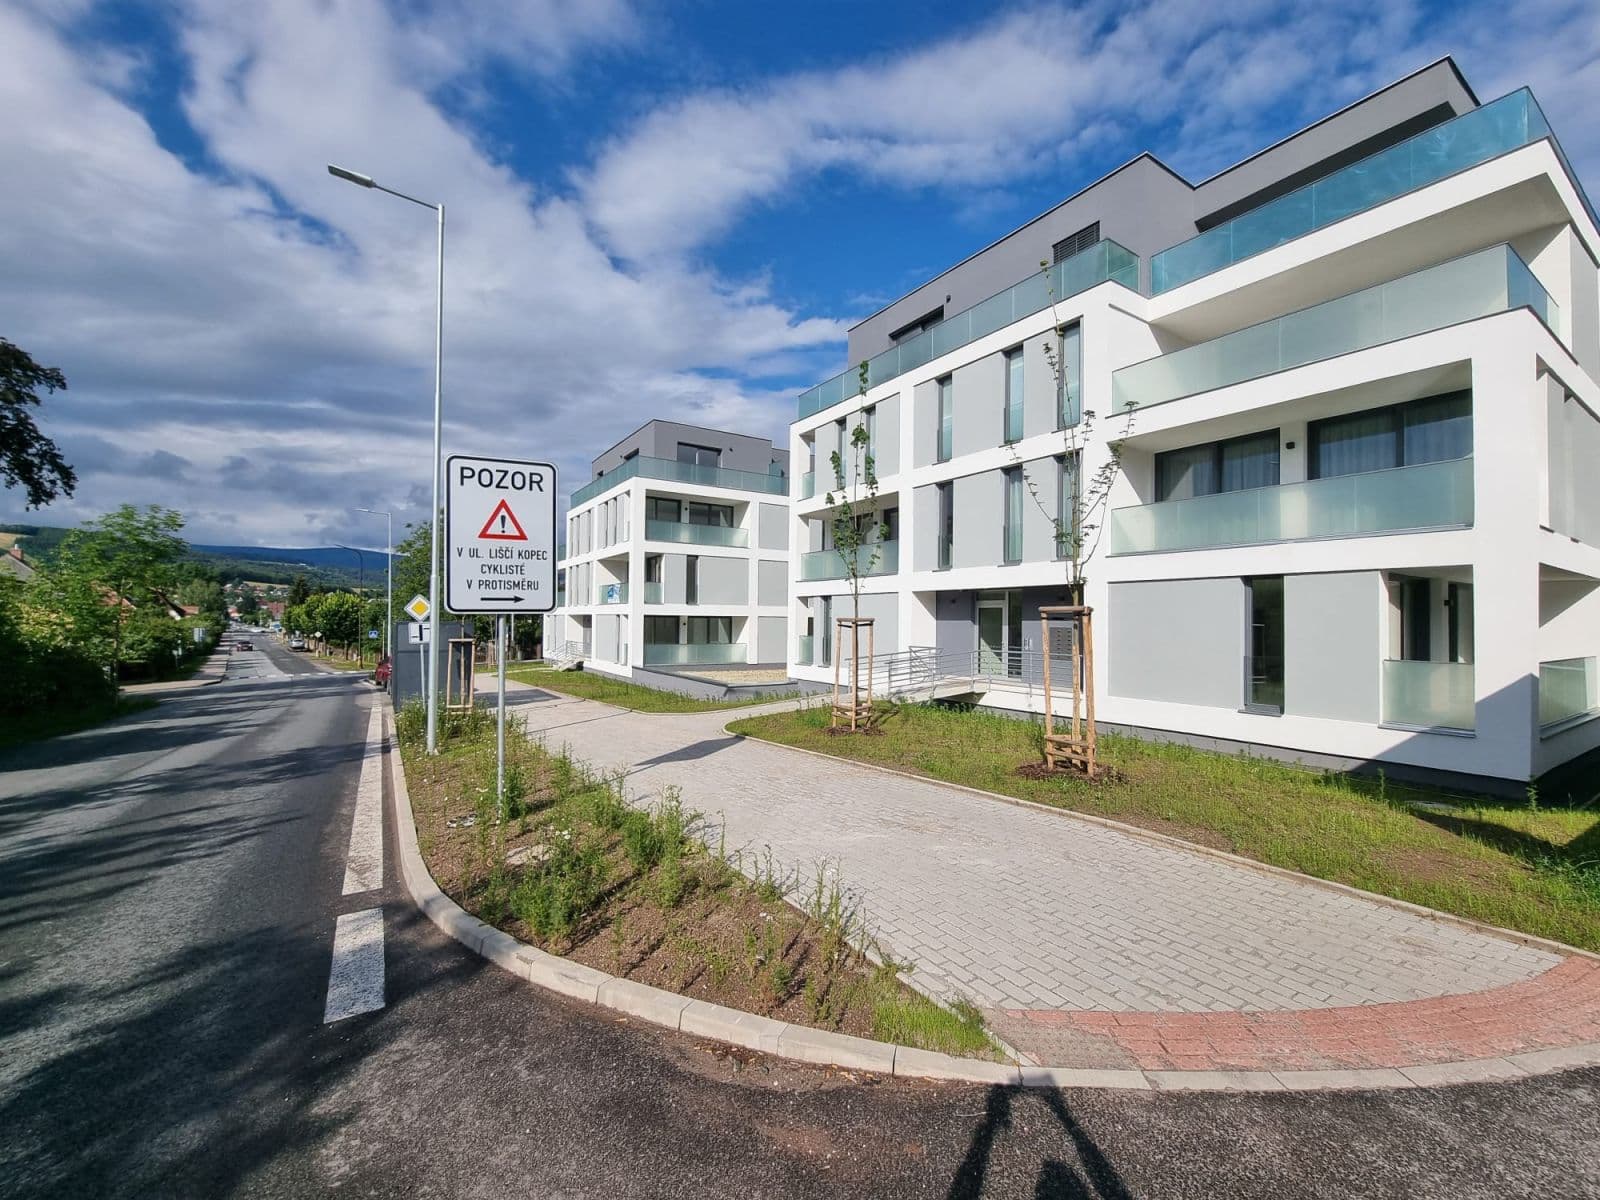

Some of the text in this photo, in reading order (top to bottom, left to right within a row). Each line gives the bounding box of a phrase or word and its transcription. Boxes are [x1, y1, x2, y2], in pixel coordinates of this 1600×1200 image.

[460, 466, 544, 492] POZOR
[457, 546, 548, 561] V UL. LIŠČÍ KOPEC
[480, 563, 525, 575] CYKLISTÉ
[466, 578, 539, 591] V PROTISMĚRU
